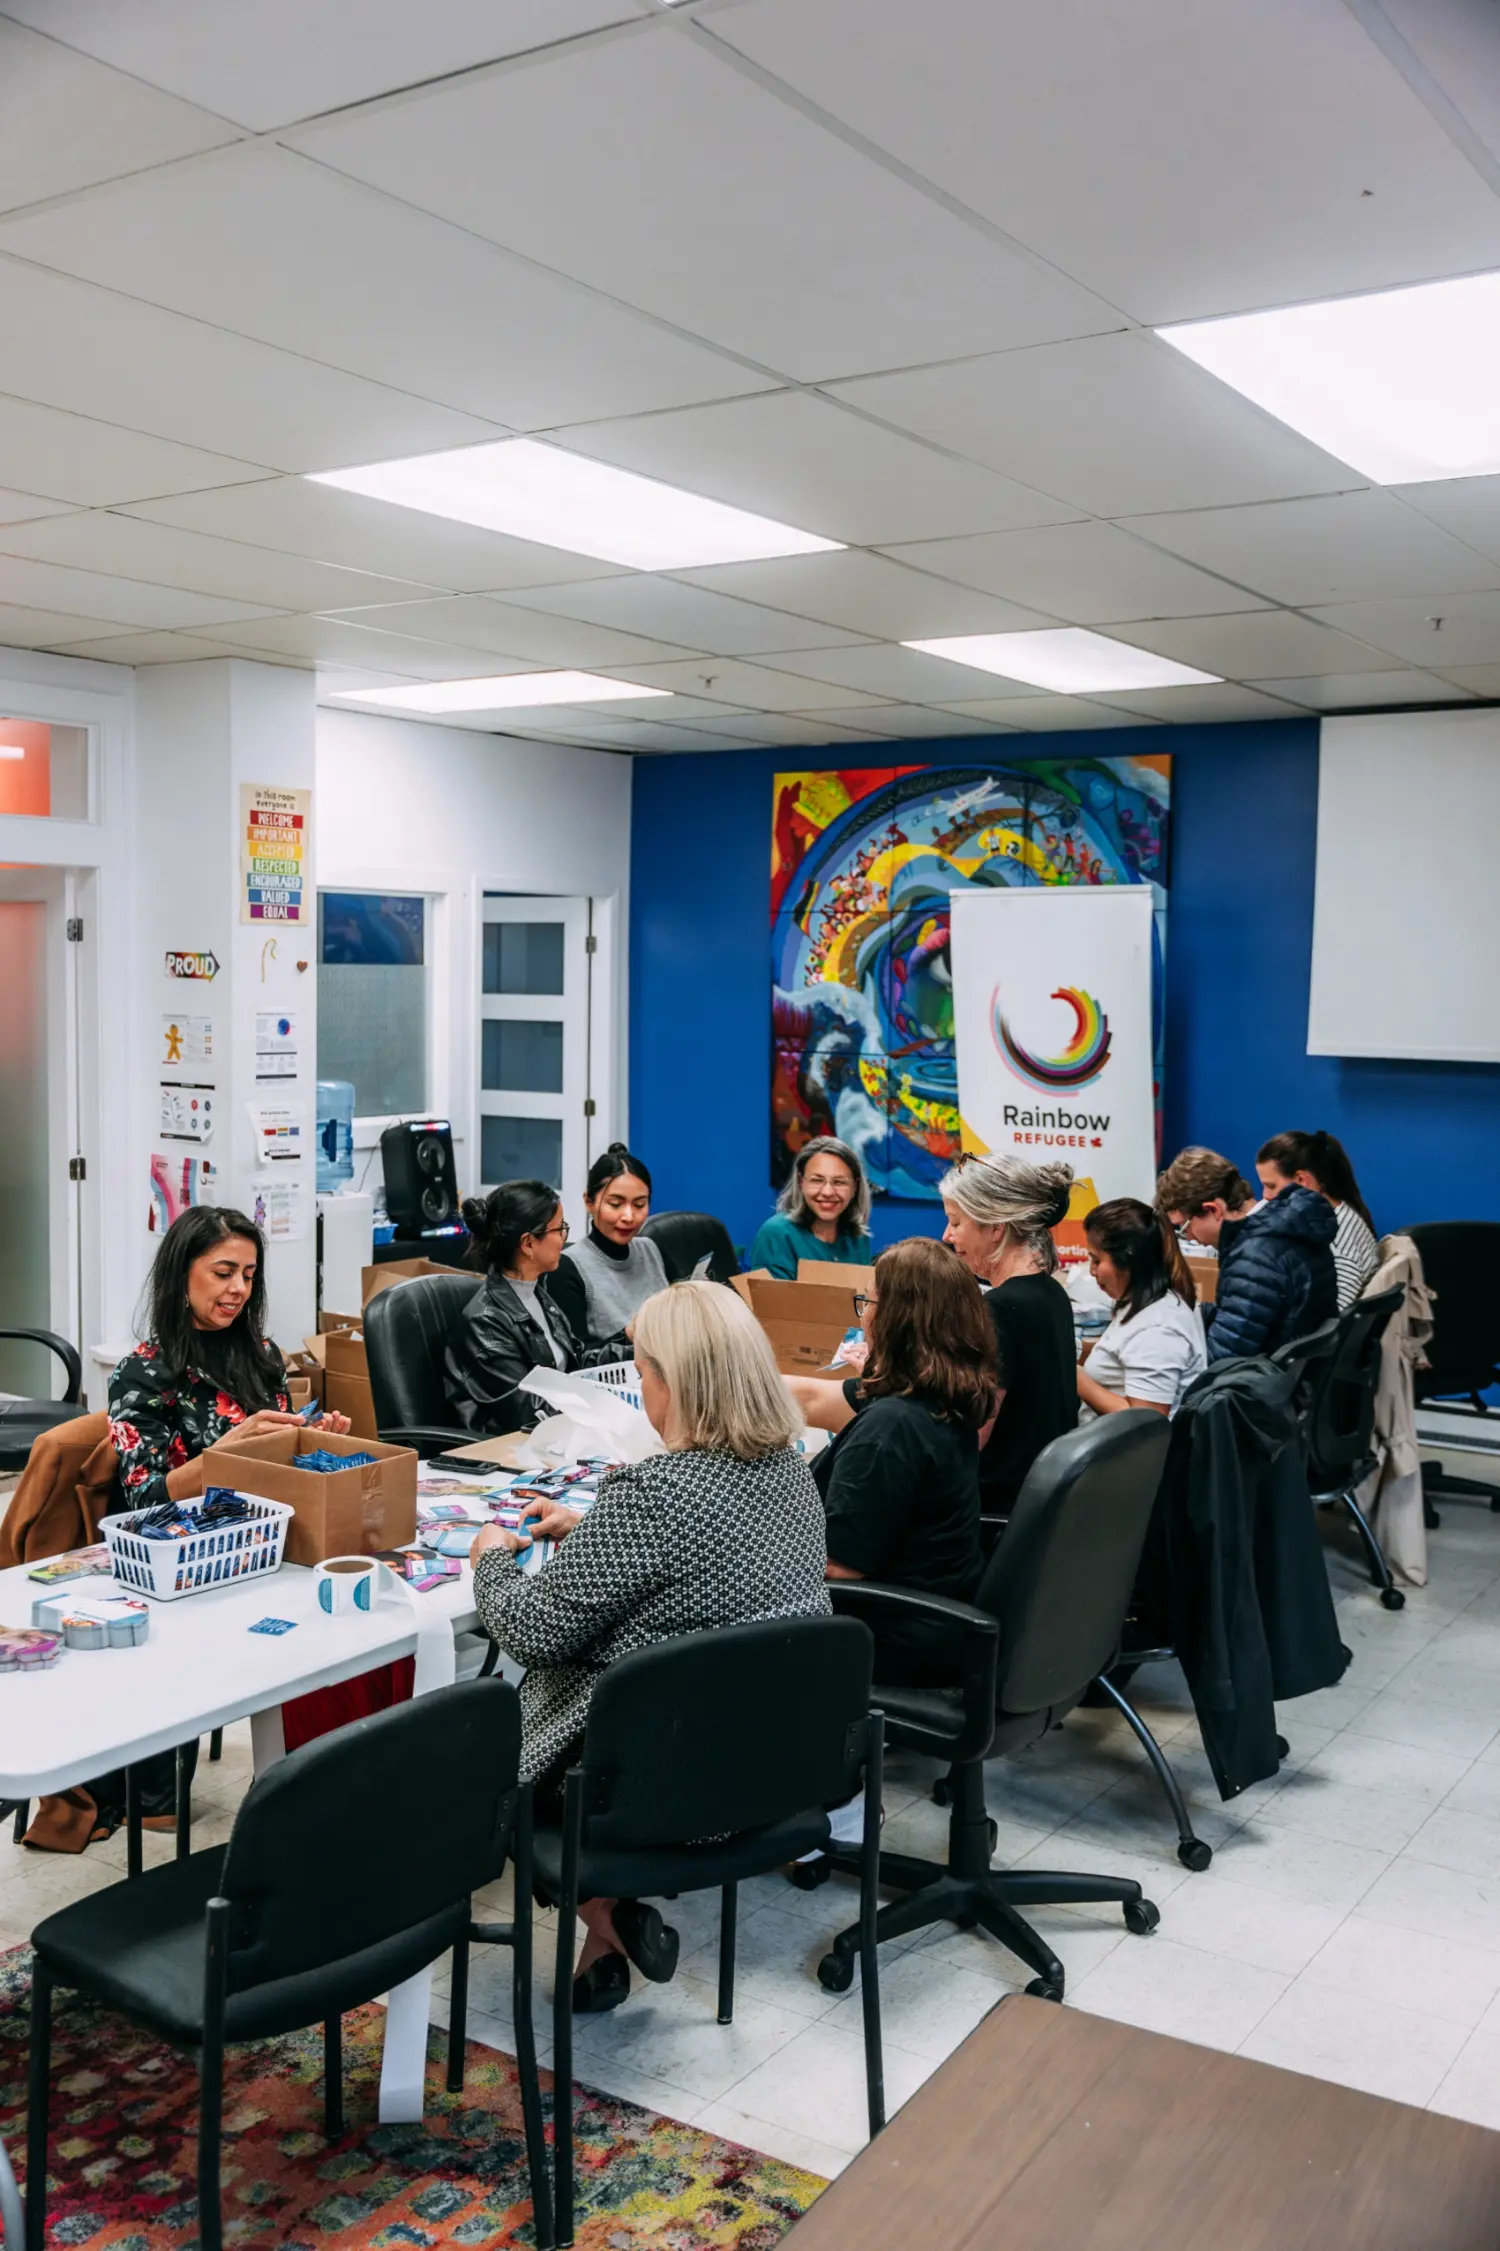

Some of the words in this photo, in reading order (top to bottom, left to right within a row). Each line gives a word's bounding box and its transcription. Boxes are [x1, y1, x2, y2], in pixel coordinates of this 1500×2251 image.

[256, 800, 287, 811] everyone
[258, 812, 293, 828] WELCOME
[253, 827, 298, 844] IMPORTANT
[255, 858, 298, 874] RESPECTED
[250, 873, 301, 889] ENCOURAGED
[261, 890, 290, 904] VALUED
[263, 905, 288, 919] EQUAL
[166, 953, 215, 978] PROUD
[1003, 1104, 1110, 1131] Rainbow
[1013, 1132, 1087, 1147] REFUGEE
[1055, 1244, 1089, 1257] ortin
